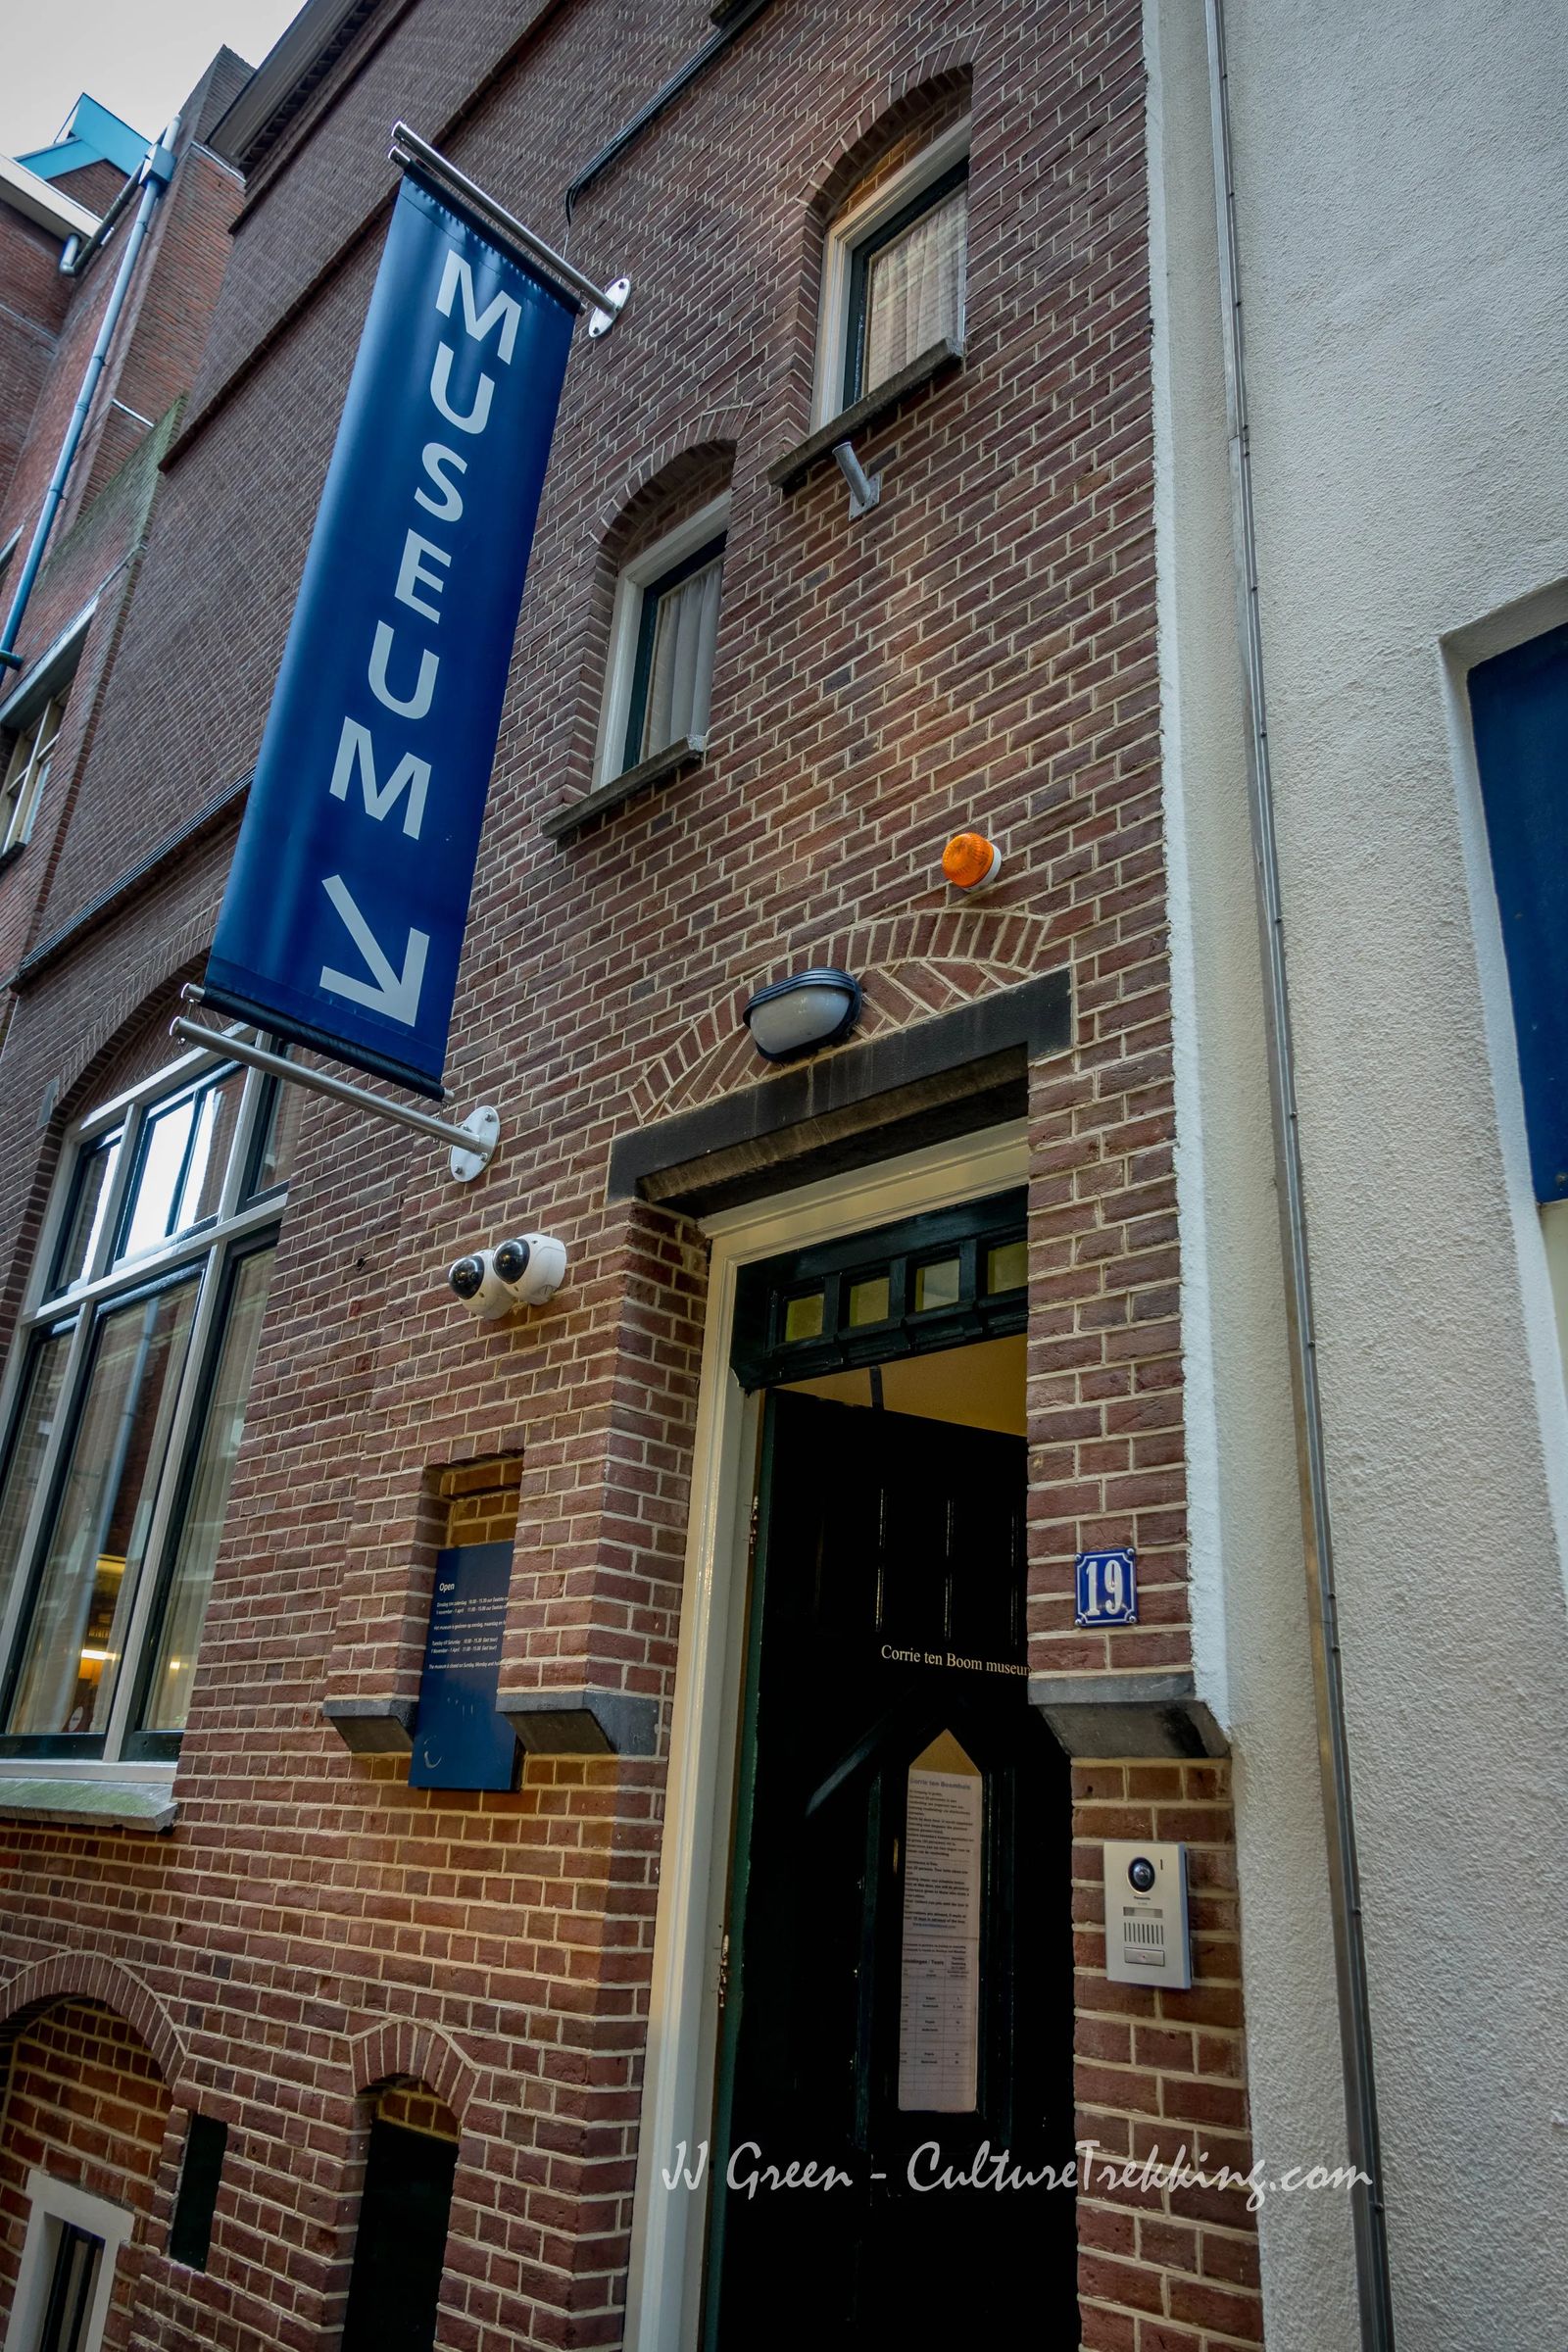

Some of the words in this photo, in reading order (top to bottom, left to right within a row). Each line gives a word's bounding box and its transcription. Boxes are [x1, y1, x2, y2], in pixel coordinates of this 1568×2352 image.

[330, 249, 521, 839] MUSEUM
[439, 1583, 455, 1592] Open
[1086, 1559, 1124, 1616] 19
[882, 1644, 920, 1662] Corrie
[924, 1651, 943, 1665] ten
[947, 1652, 983, 1670] Boom
